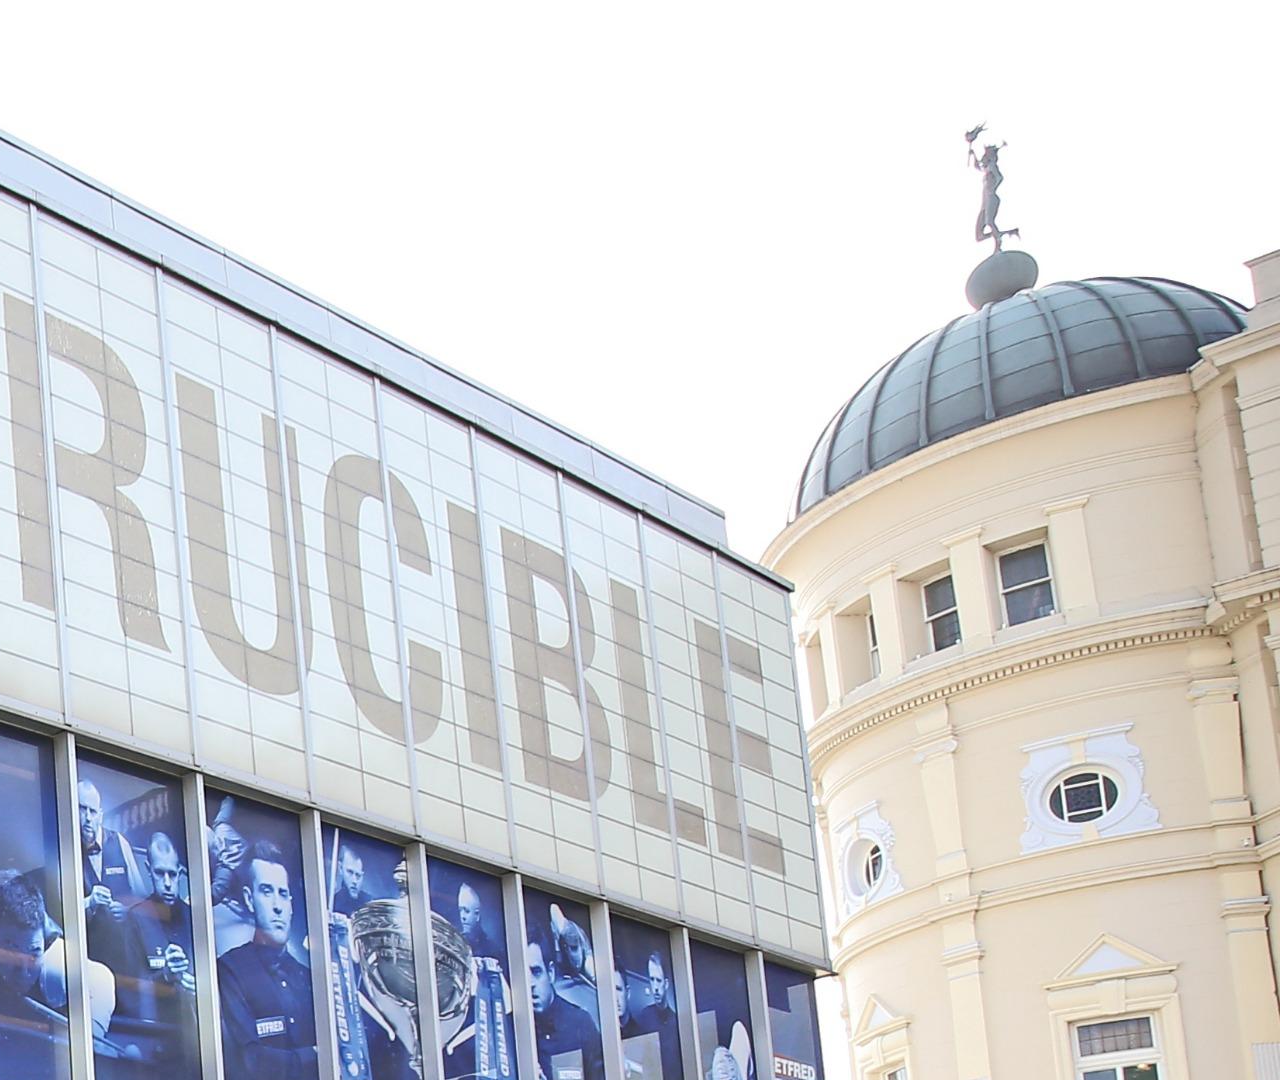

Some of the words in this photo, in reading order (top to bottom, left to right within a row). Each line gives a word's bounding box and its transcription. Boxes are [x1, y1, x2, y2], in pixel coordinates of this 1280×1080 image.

[256, 1020, 284, 1035] ETFRED
[479, 999, 490, 1077] BETFRED
[495, 1002, 510, 1077] BETFRED
[774, 1056, 816, 1080] ETFRED
